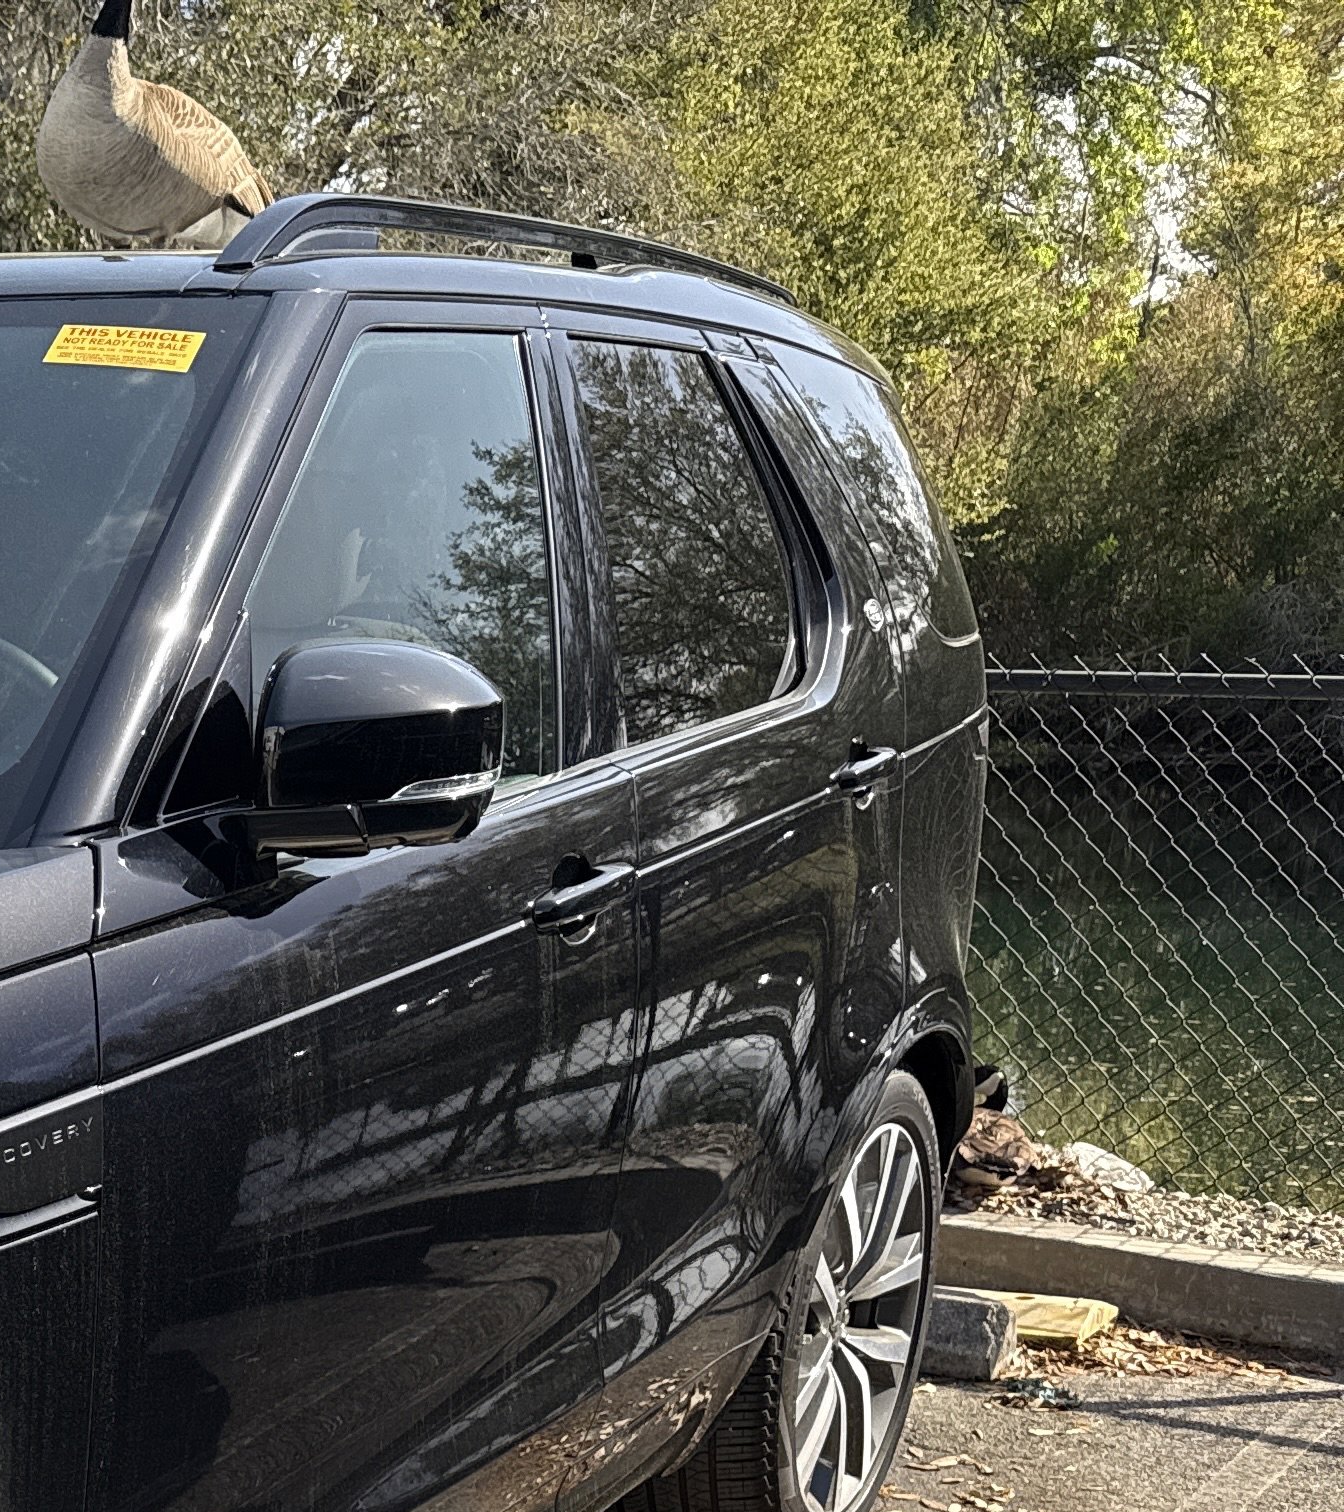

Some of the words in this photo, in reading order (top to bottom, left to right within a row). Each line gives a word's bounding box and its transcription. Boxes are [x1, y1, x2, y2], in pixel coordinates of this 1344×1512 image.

[68, 327, 110, 337] THIS
[116, 329, 194, 343] VEHICLE
[63, 337, 86, 345] NOT
[89, 338, 130, 347] READY
[130, 340, 154, 349] FOR
[157, 342, 188, 351] SALE
